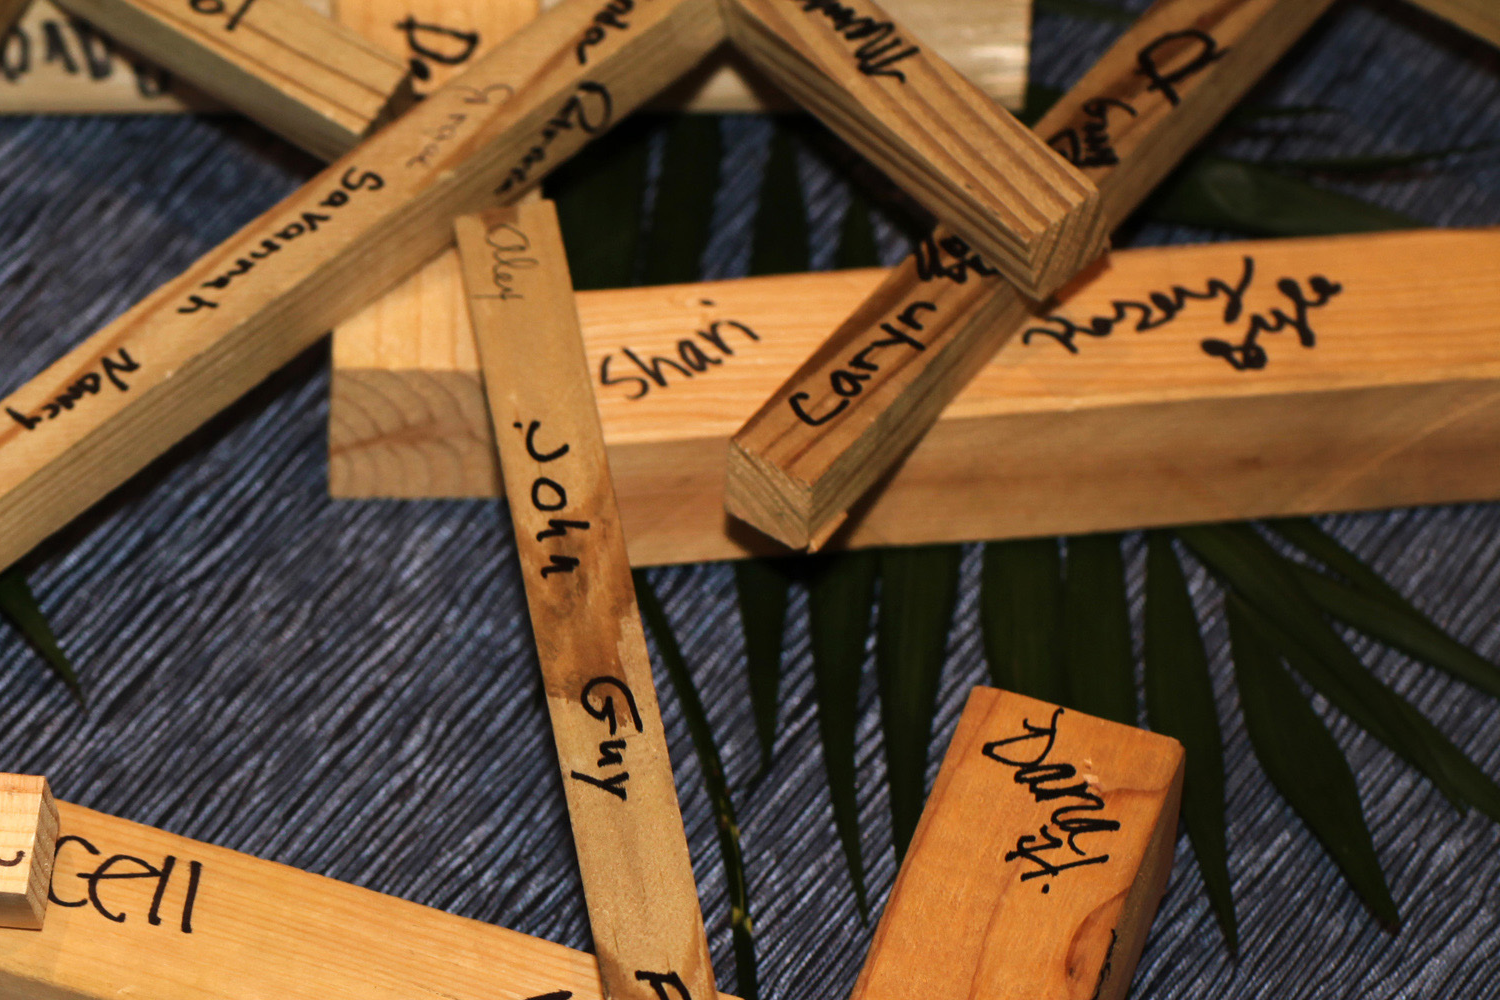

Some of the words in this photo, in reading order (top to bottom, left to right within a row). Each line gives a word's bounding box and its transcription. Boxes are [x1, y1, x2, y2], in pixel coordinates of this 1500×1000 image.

[177, 166, 386, 317] Savannah
[5, 347, 140, 432] Nancy
[790, 300, 937, 426] Caryn
[512, 420, 591, 579] John
[571, 675, 642, 801] Guy
